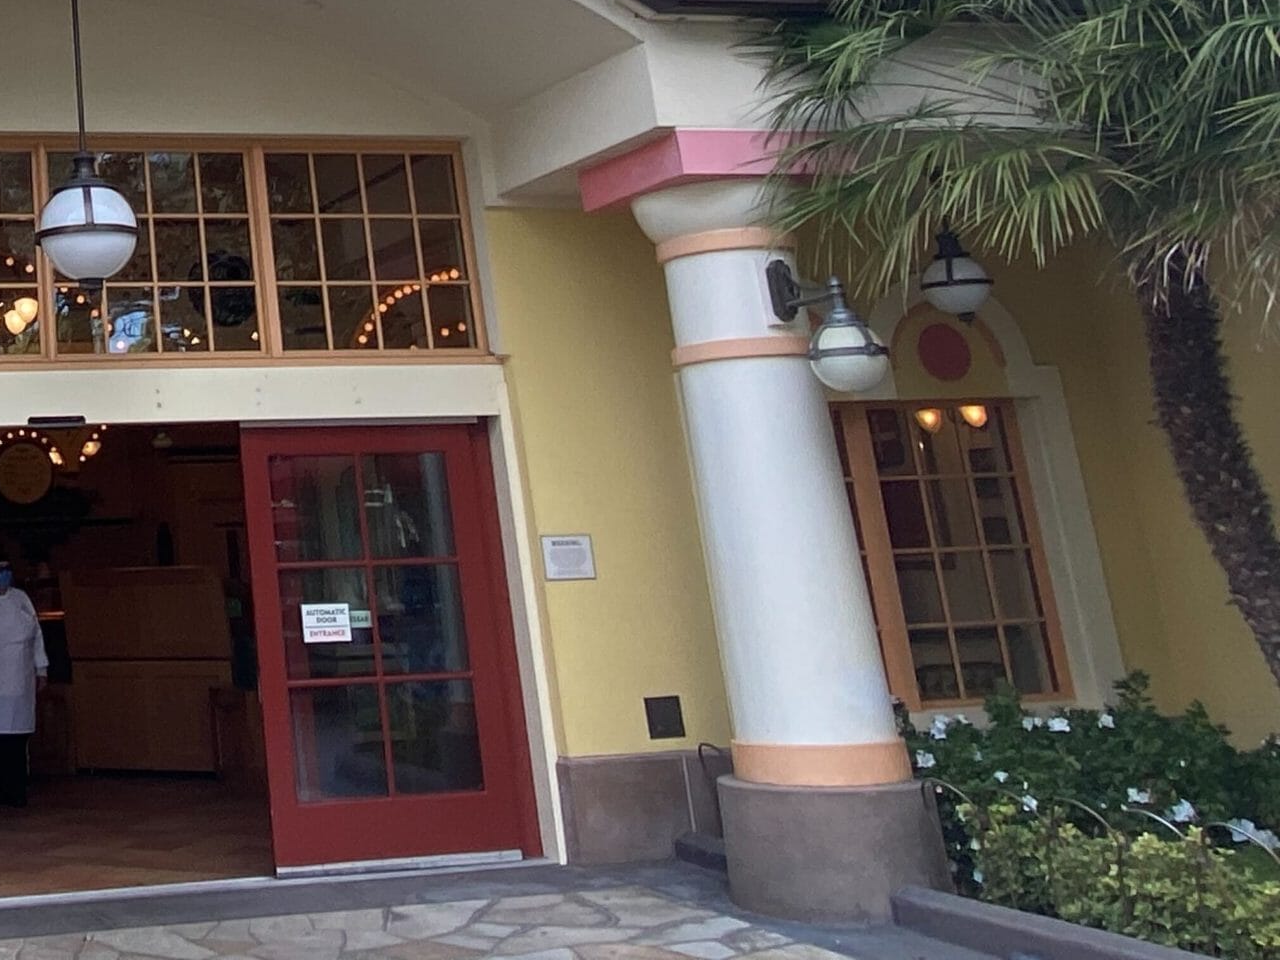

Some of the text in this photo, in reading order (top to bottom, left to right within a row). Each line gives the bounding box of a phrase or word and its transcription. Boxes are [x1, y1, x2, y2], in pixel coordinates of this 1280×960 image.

[306, 607, 347, 617] AUTOMATIC
[316, 616, 338, 624] DOOR
[309, 629, 346, 638] ENTRANCE
